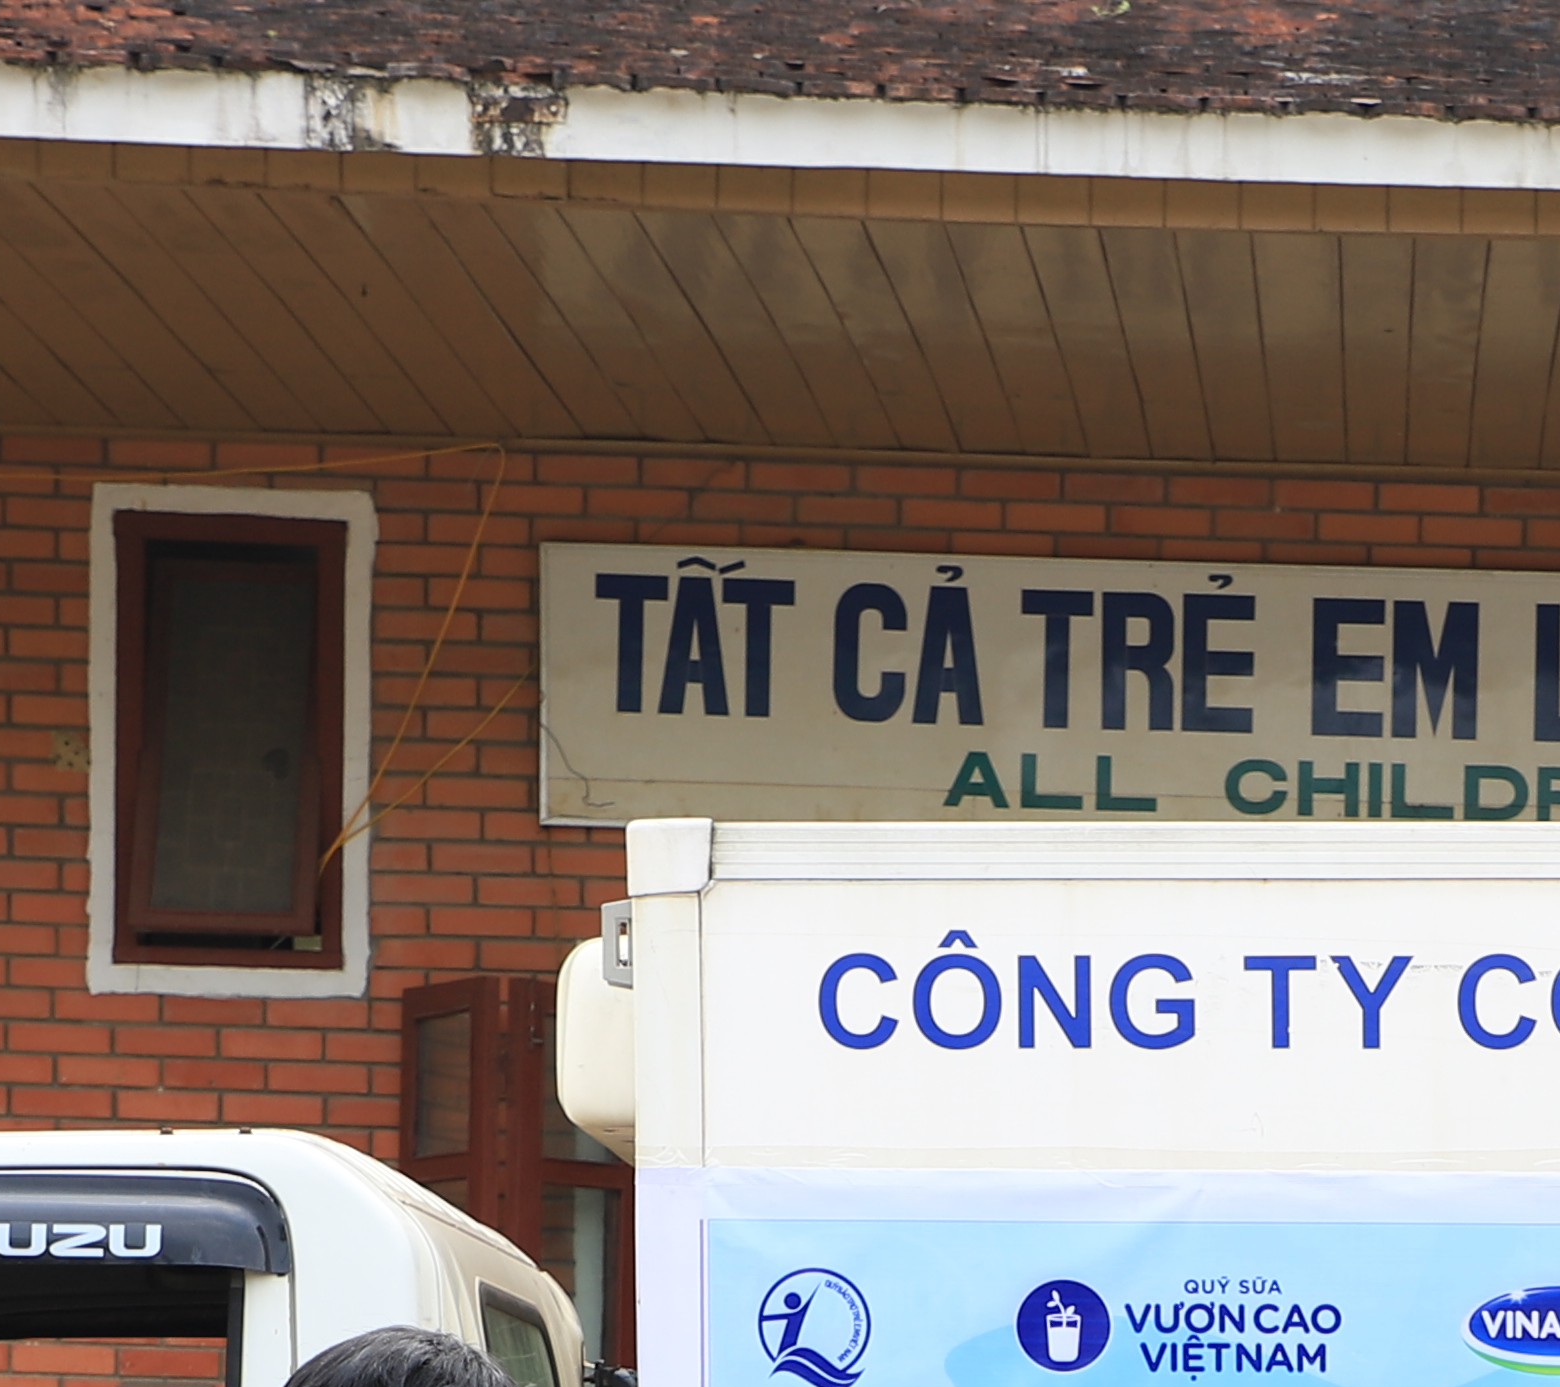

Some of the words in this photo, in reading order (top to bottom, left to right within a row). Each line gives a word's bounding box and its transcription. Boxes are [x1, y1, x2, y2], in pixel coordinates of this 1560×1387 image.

[596, 556, 795, 718] TẤT
[834, 565, 984, 726] CẢ
[1023, 575, 1255, 733] TRẺ
[1312, 599, 1479, 740] EM
[945, 751, 1157, 812] ALL
[819, 930, 1196, 1052] CÔNG
[1244, 954, 1410, 1049] TY
[1184, 1276, 1230, 1294] QUỸ
[1239, 1276, 1282, 1294] SỮA
[1125, 1302, 1245, 1334] VƯƠN
[1253, 1304, 1341, 1334] CAO
[1236, 1343, 1326, 1372] NAM
